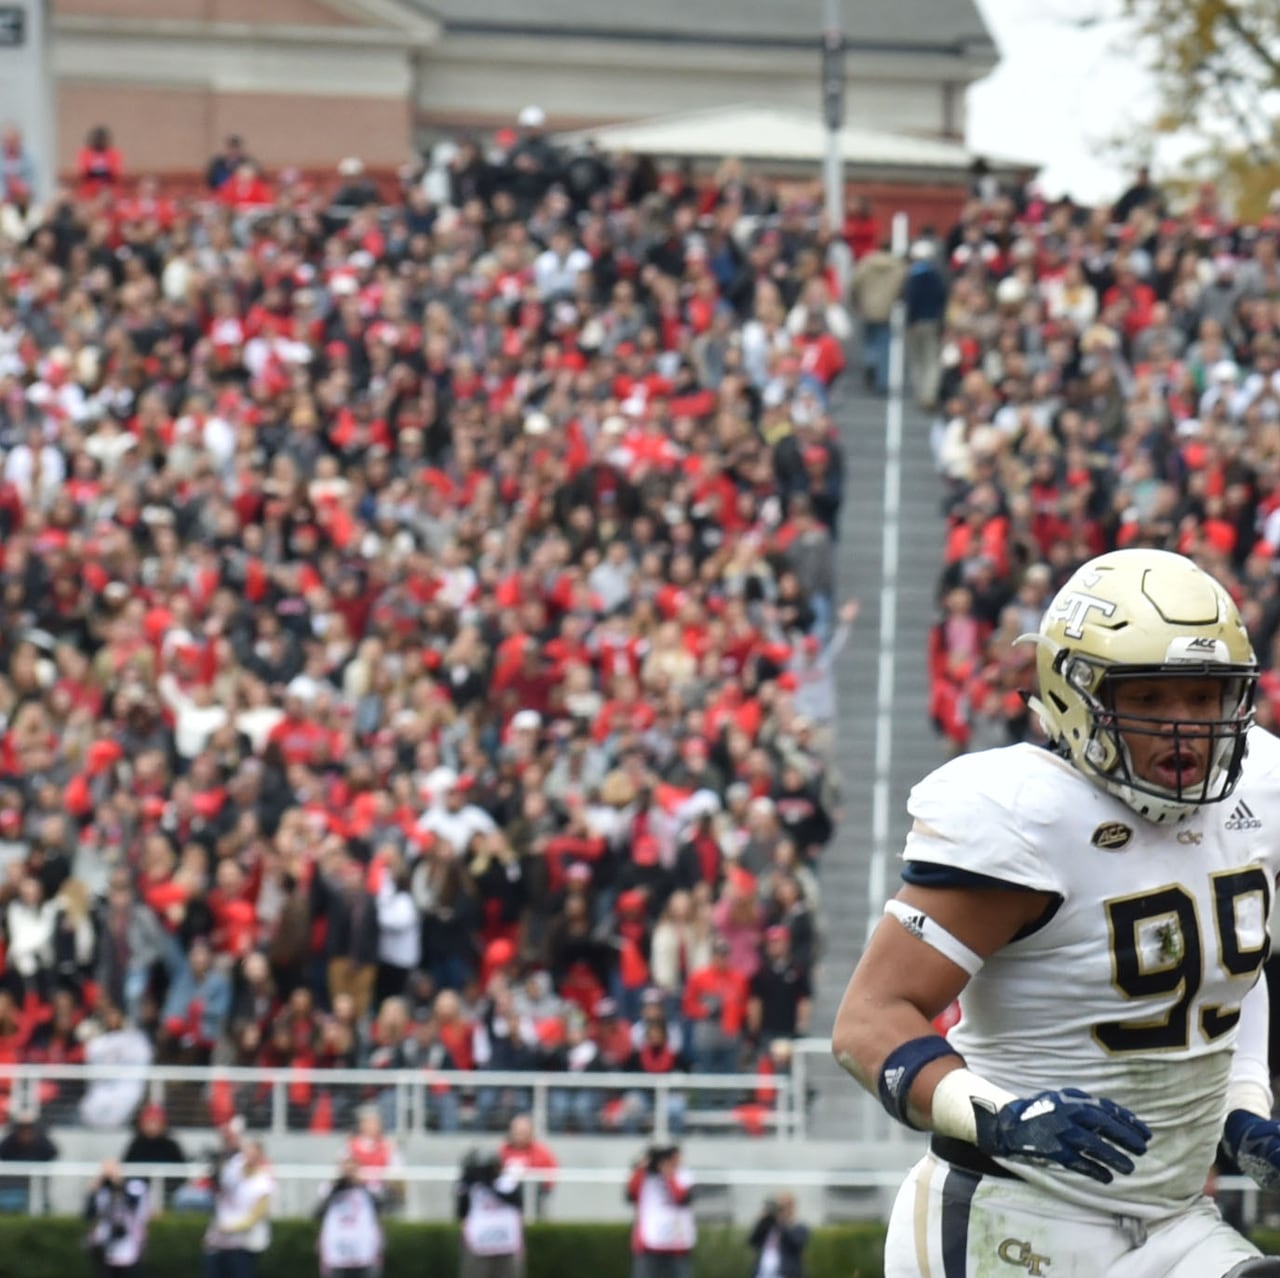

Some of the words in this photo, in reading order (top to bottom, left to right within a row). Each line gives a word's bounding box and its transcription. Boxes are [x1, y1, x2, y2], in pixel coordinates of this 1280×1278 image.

[1187, 637, 1217, 651] ACC
[1225, 818, 1263, 831] adidas
[1099, 828, 1129, 845] ACC
[1090, 862, 1272, 1056] 99
[997, 1237, 1051, 1278] GT
